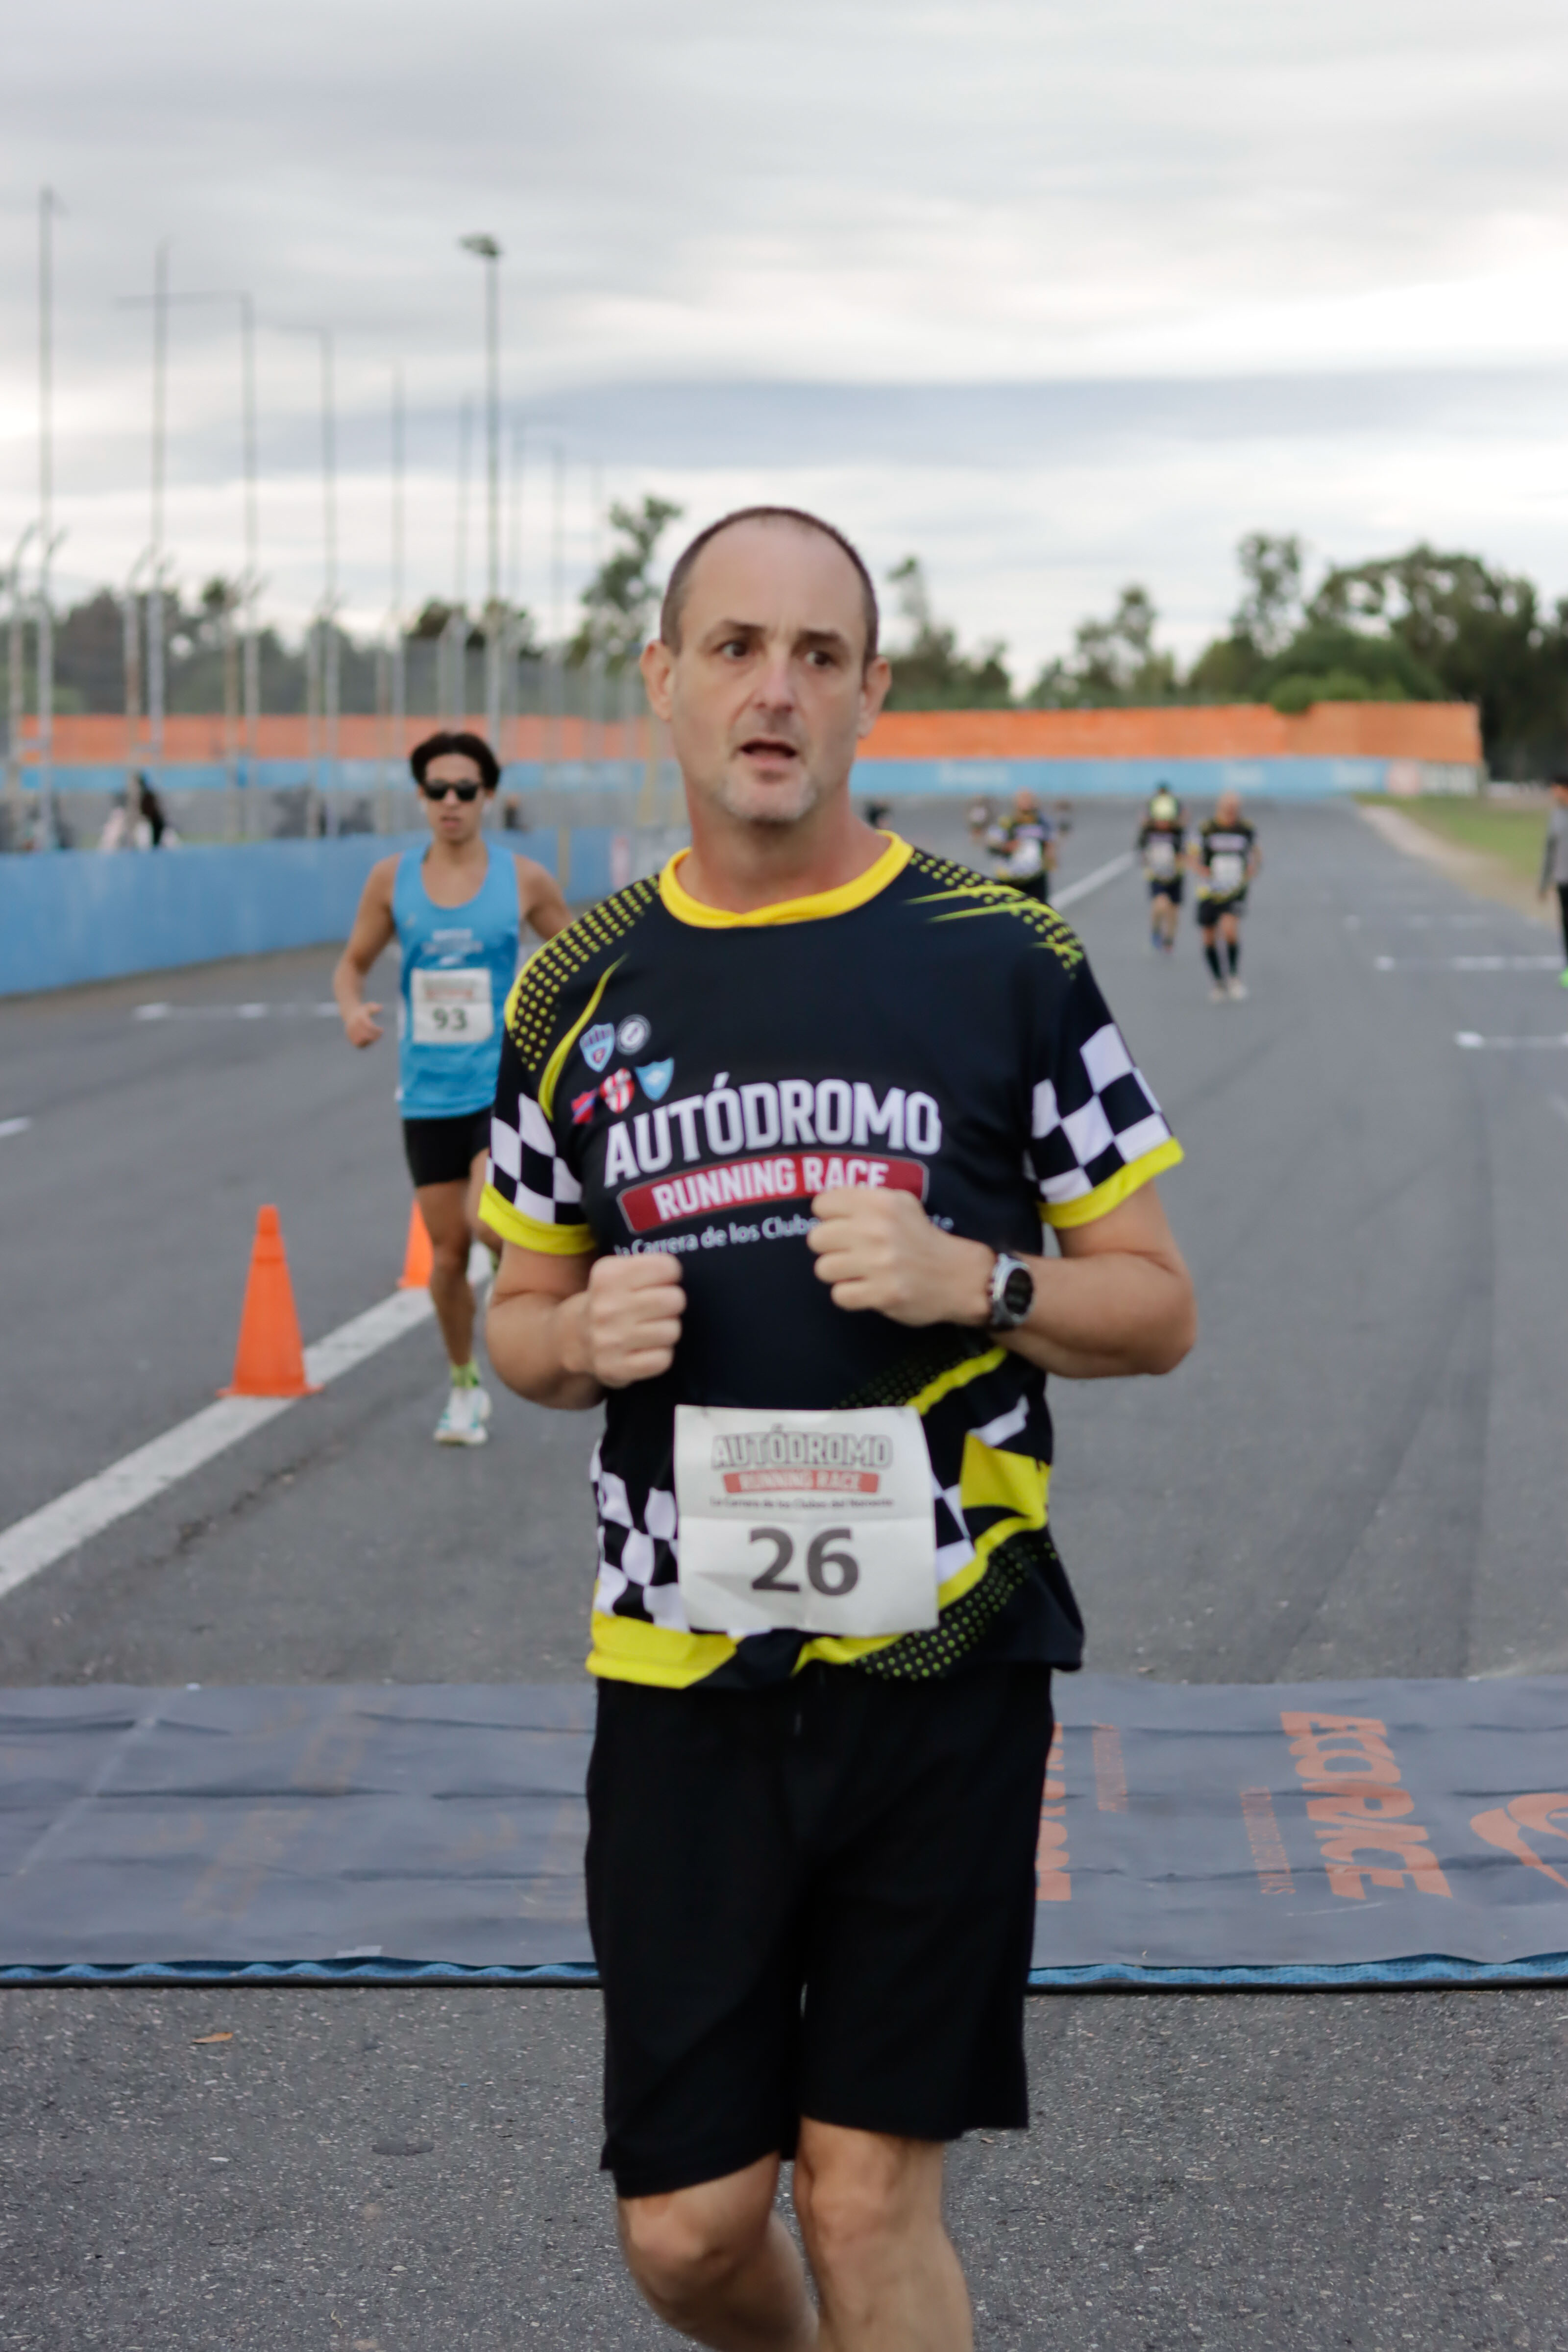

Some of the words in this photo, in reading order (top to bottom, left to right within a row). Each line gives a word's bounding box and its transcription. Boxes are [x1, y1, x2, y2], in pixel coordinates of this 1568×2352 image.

[433, 1008, 468, 1030] 93
[604, 1071, 942, 1188] AUTÓDROMO
[652, 1157, 796, 1221] RUNNING
[802, 1156, 889, 1193] RACE
[701, 1226, 727, 1249] de
[729, 1222, 760, 1244] los
[711, 1423, 894, 1470] AUTÓDROMO
[738, 1470, 812, 1491] RUNNING
[817, 1470, 861, 1491] RACE
[749, 1527, 859, 1595] 26
